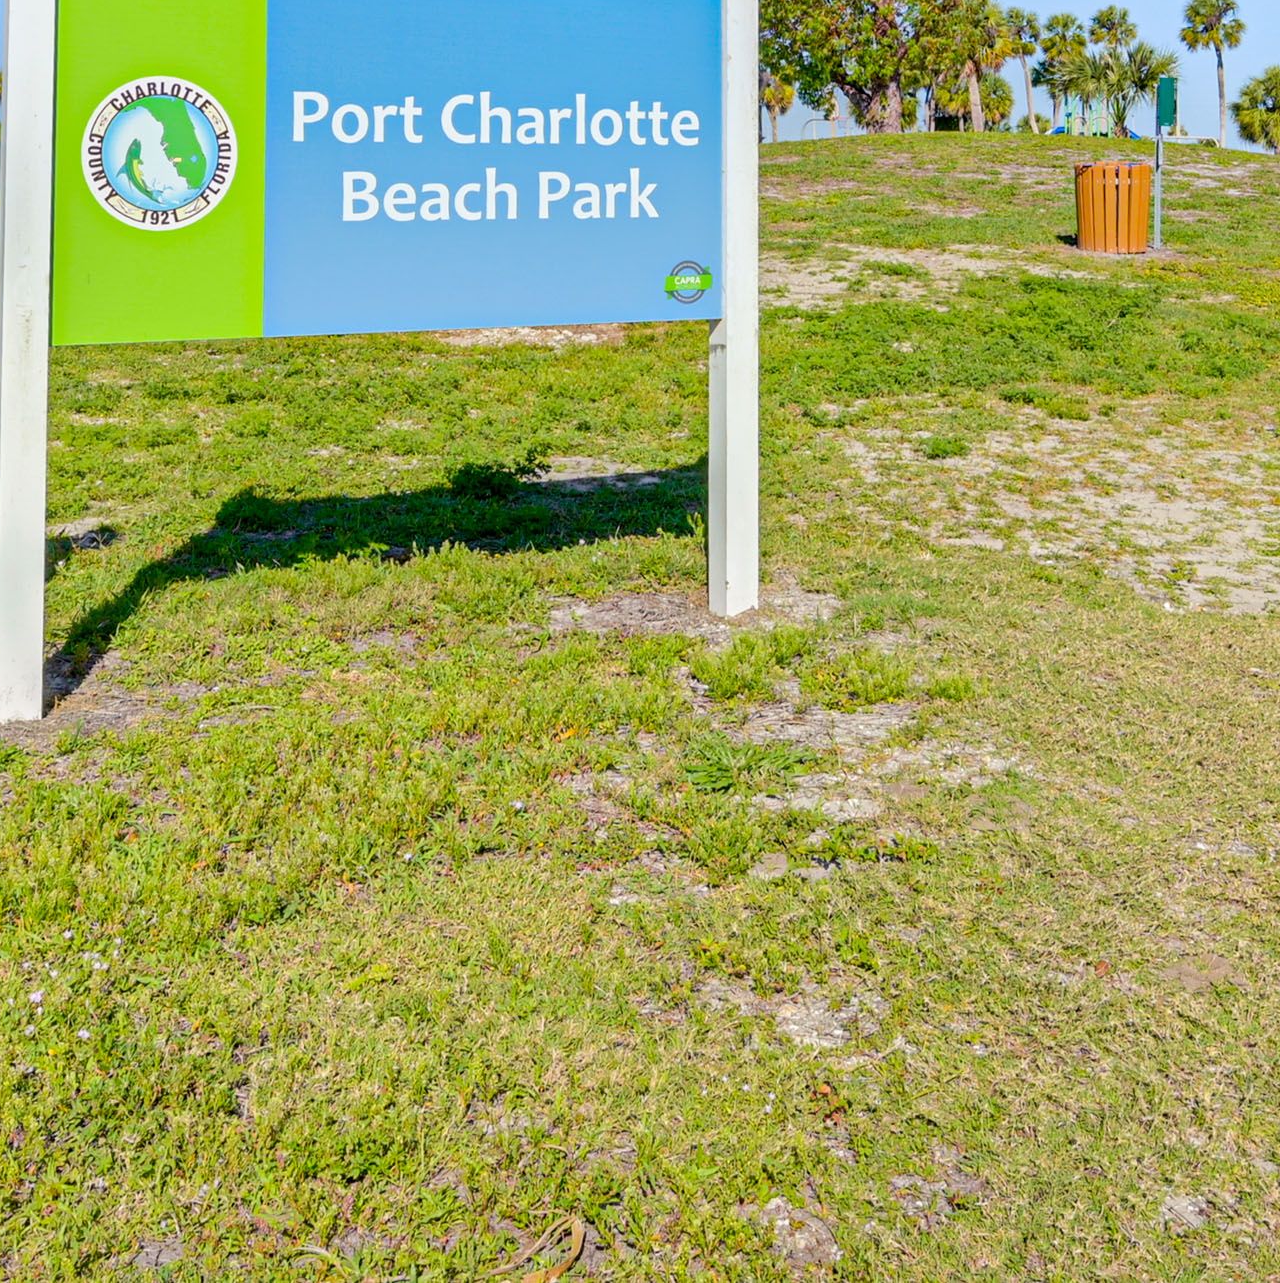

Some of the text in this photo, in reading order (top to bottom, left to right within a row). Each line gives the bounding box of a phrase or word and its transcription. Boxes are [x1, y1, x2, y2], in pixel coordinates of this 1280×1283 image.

[109, 82, 212, 111] CHARLOTTE
[292, 90, 701, 146] Port Charlotte
[88, 133, 119, 202] COUNTY
[201, 130, 231, 204] FLORIDA
[342, 167, 659, 222] Beach Park
[141, 210, 180, 224] 1921
[675, 276, 700, 284] CAPRA
